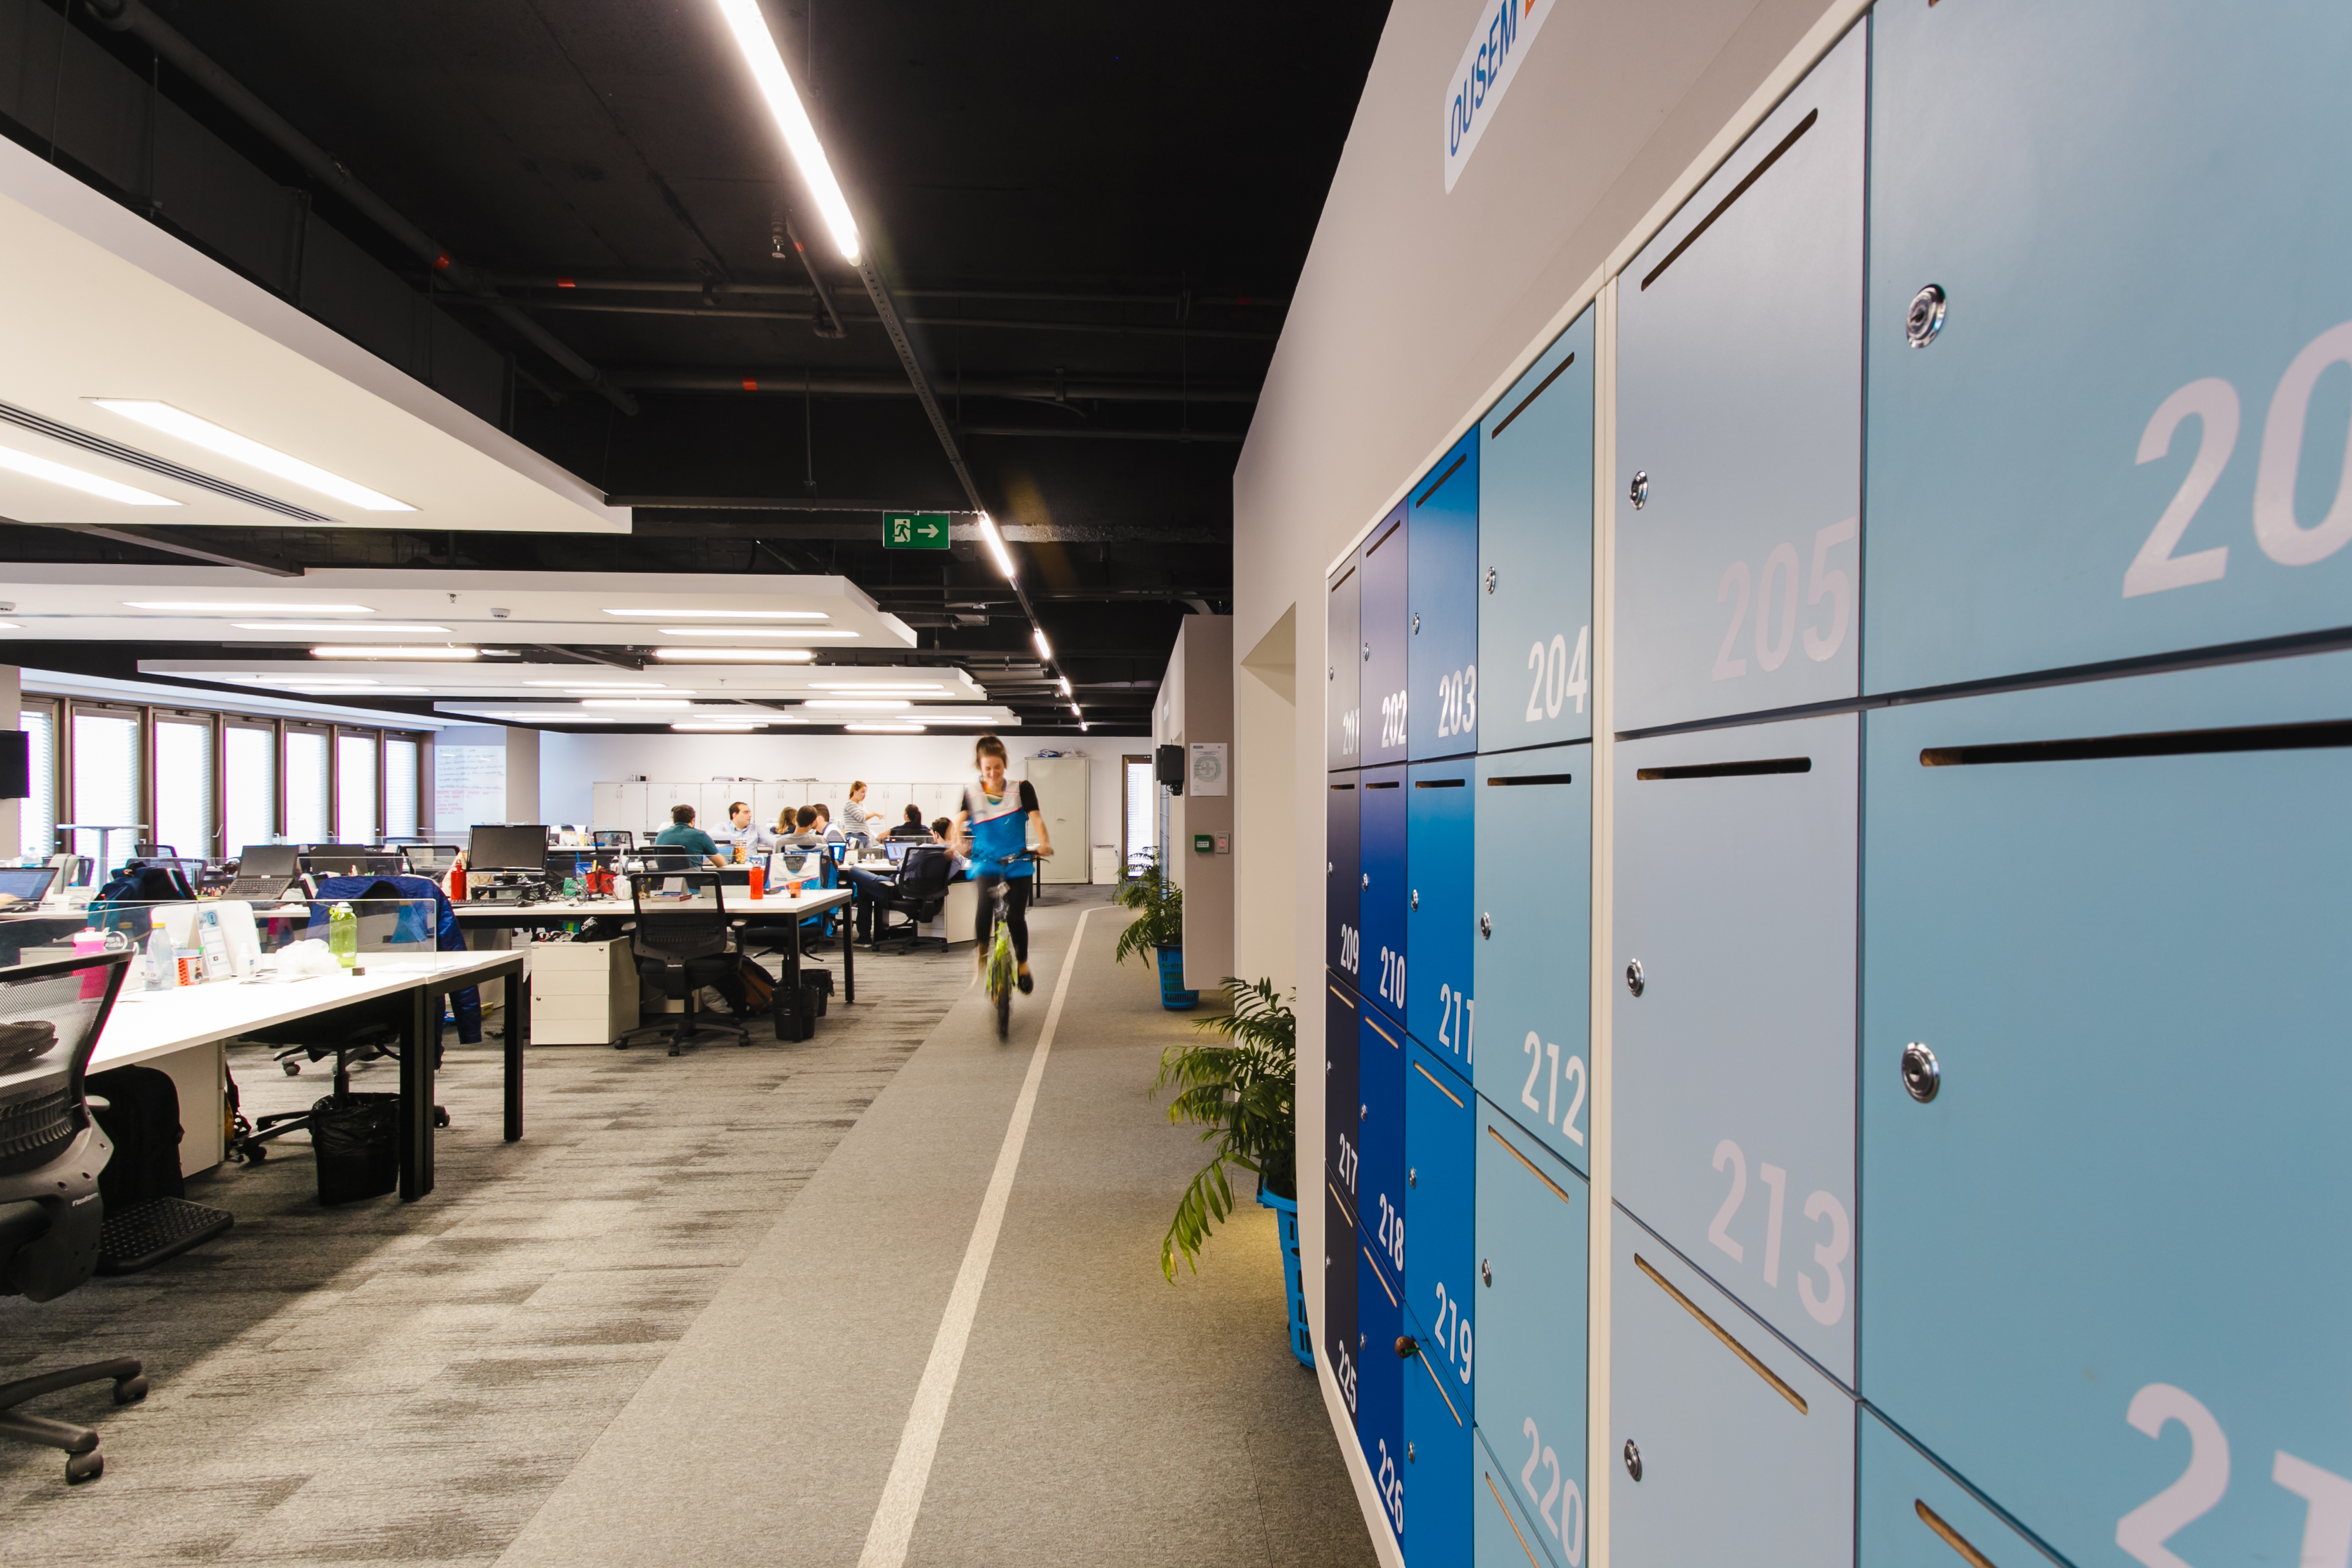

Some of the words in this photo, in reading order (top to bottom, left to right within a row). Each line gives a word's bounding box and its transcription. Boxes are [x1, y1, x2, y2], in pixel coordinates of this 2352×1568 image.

[1450, 0, 1517, 157] OUSEM
[1711, 516, 1856, 681] 205
[1438, 665, 1476, 738] 203
[1526, 625, 1588, 722] 204
[1343, 708, 1359, 755] 201
[1381, 689, 1406, 748] 202
[1341, 923, 1359, 975] 209
[1380, 946, 1405, 1009] 210
[1438, 983, 1474, 1065] 211
[1522, 1030, 1586, 1147] 212
[1339, 1133, 1357, 1195] 217
[1379, 1193, 1404, 1272] 218
[1708, 1139, 1851, 1326] 213
[1434, 1282, 1472, 1384] 219
[1338, 1340, 1357, 1414] 225
[1379, 1438, 1403, 1535] 226
[1521, 1417, 1583, 1567] 220
